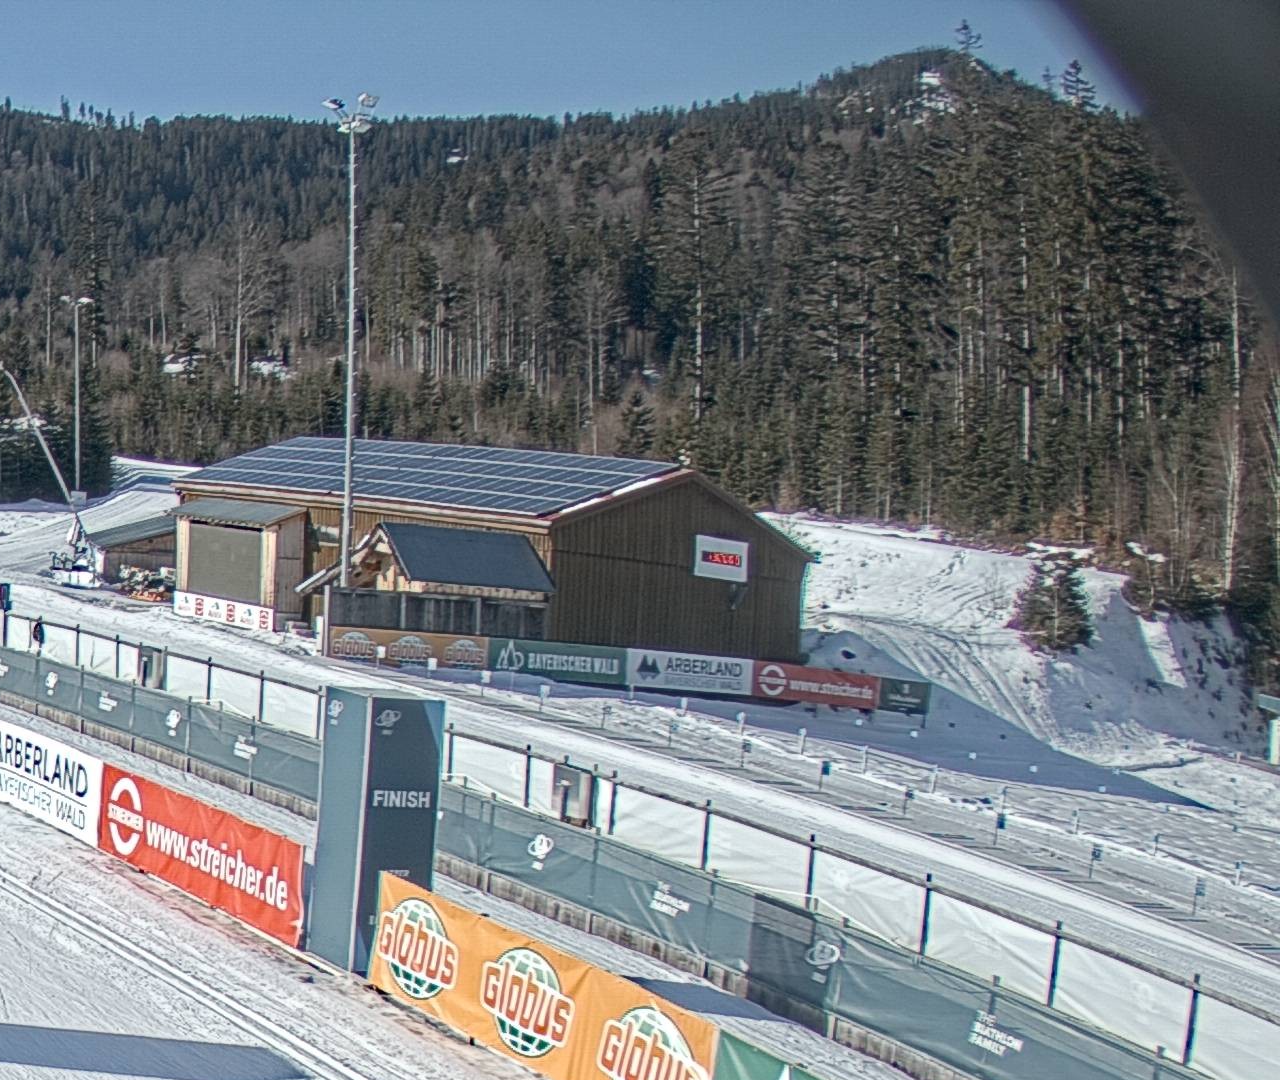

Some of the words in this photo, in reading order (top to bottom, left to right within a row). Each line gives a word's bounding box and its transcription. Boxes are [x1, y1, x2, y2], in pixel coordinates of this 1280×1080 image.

[528, 652, 591, 673] BAYERISCHER
[592, 657, 620, 675] WALD
[665, 656, 743, 678] ARBERLAND
[372, 790, 431, 809] FINISH
[56, 798, 86, 830] WALD
[146, 819, 288, 911] www.streicher.de
